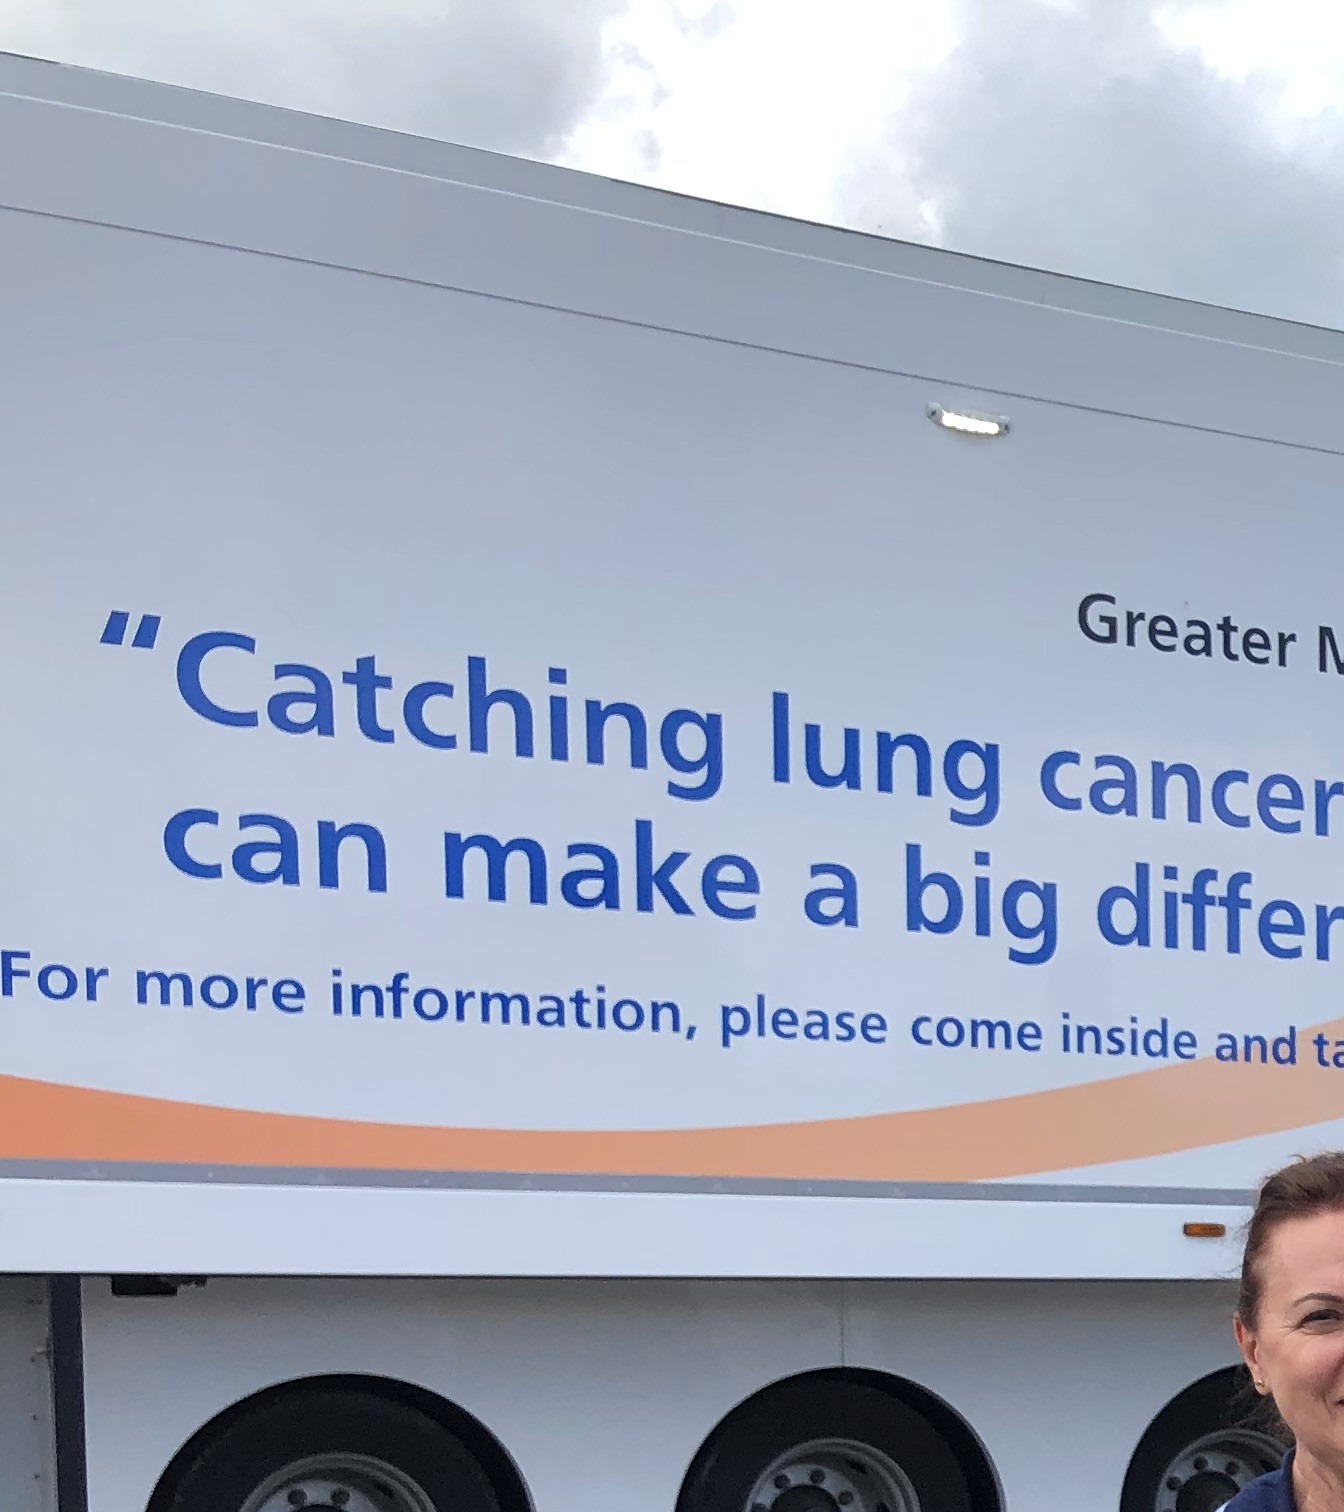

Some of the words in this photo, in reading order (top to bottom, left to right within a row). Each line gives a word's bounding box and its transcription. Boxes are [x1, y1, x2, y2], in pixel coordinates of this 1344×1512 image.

[1078, 593, 1297, 667] Greater
[772, 691, 1000, 827] lung
[1040, 747, 1344, 837] cancer
[164, 808, 387, 892] can
[444, 819, 760, 921] make
[803, 861, 858, 928] a
[905, 843, 1058, 965] big
[1, 951, 108, 1001] For
[136, 969, 306, 1014] more
[331, 969, 698, 1040] information,
[721, 994, 888, 1048] please
[911, 1015, 1042, 1052] come
[1061, 1013, 1197, 1060] inside
[1215, 1026, 1297, 1065] and
